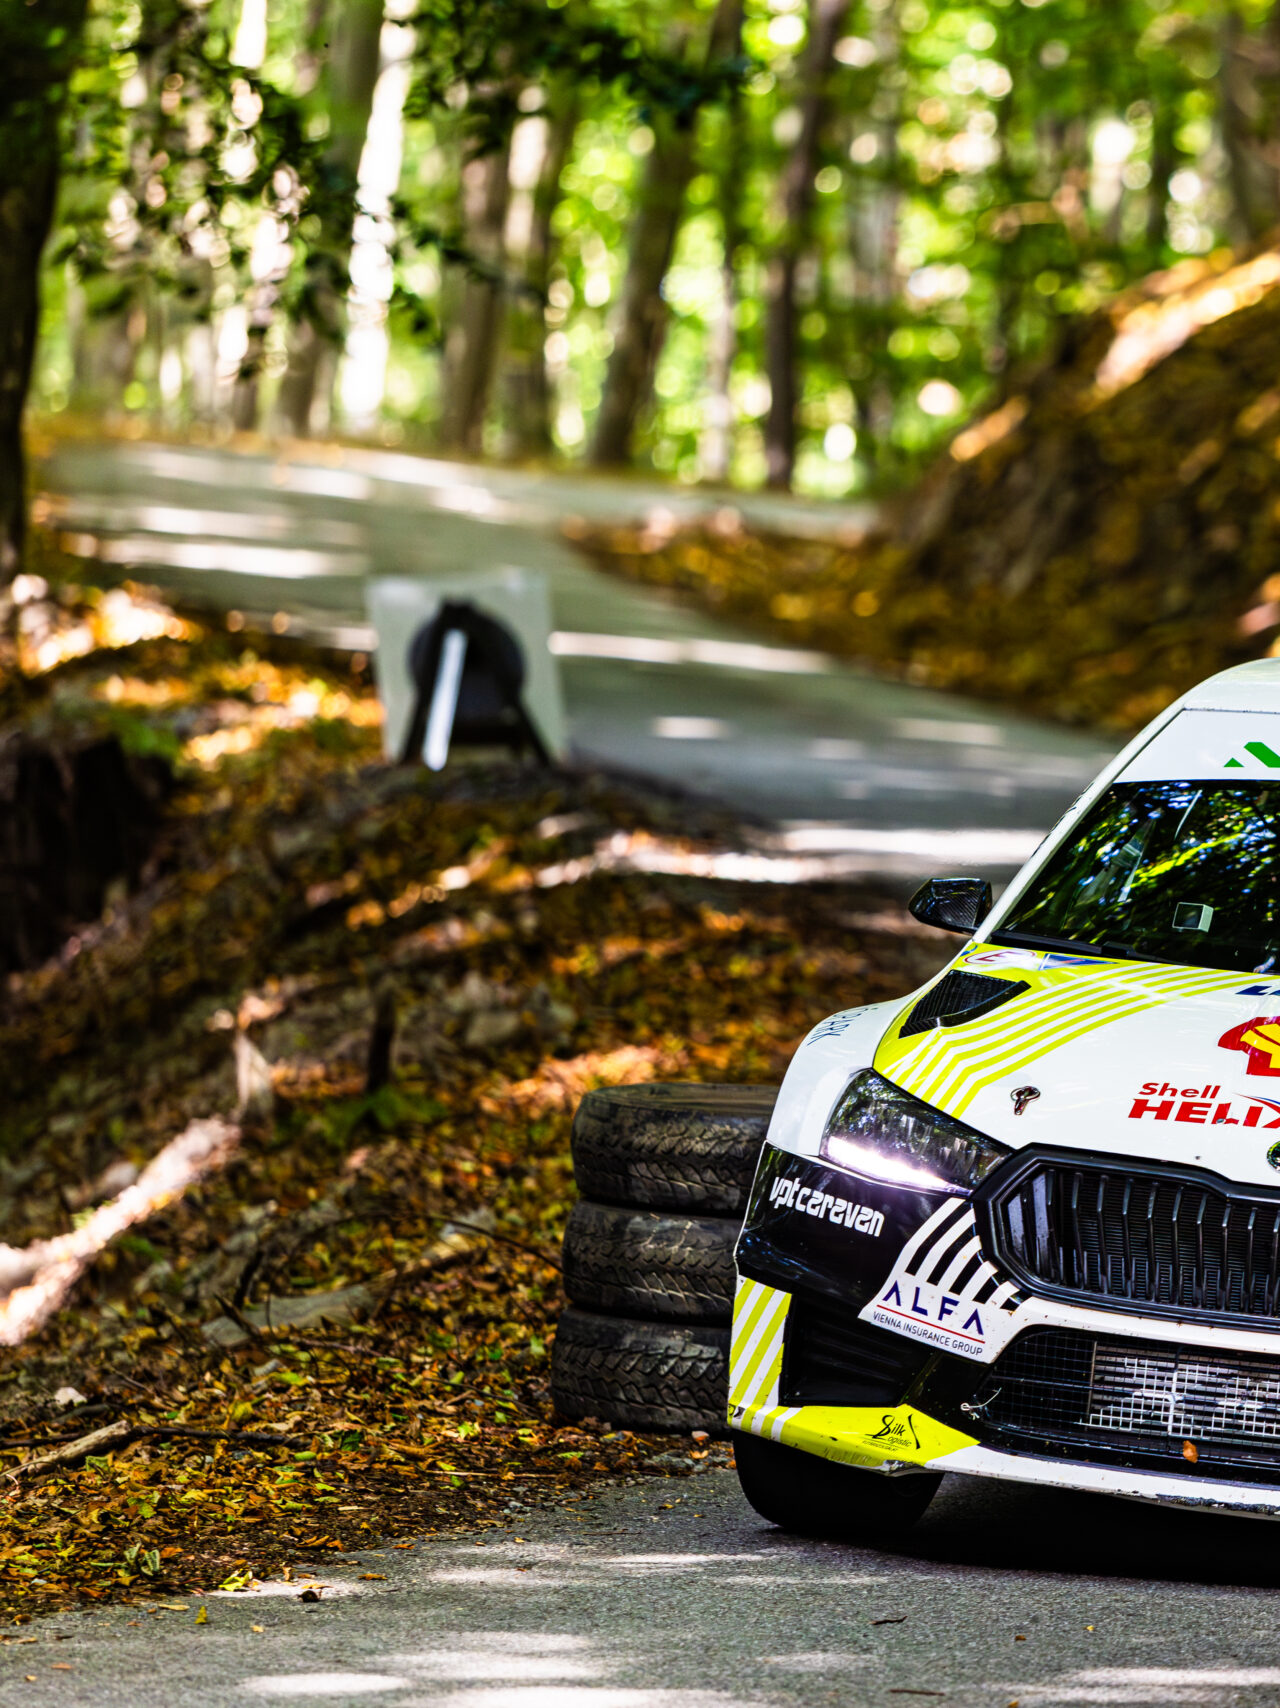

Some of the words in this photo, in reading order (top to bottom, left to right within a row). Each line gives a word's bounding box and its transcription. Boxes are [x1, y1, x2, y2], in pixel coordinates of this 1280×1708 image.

[1138, 1082, 1222, 1100] Shell
[882, 1280, 985, 1336] ALFA
[873, 1310, 902, 1330] VIENNA
[902, 1321, 954, 1346] INSURANCE
[951, 1339, 983, 1357] GROUP
[867, 1414, 907, 1439] Silk
